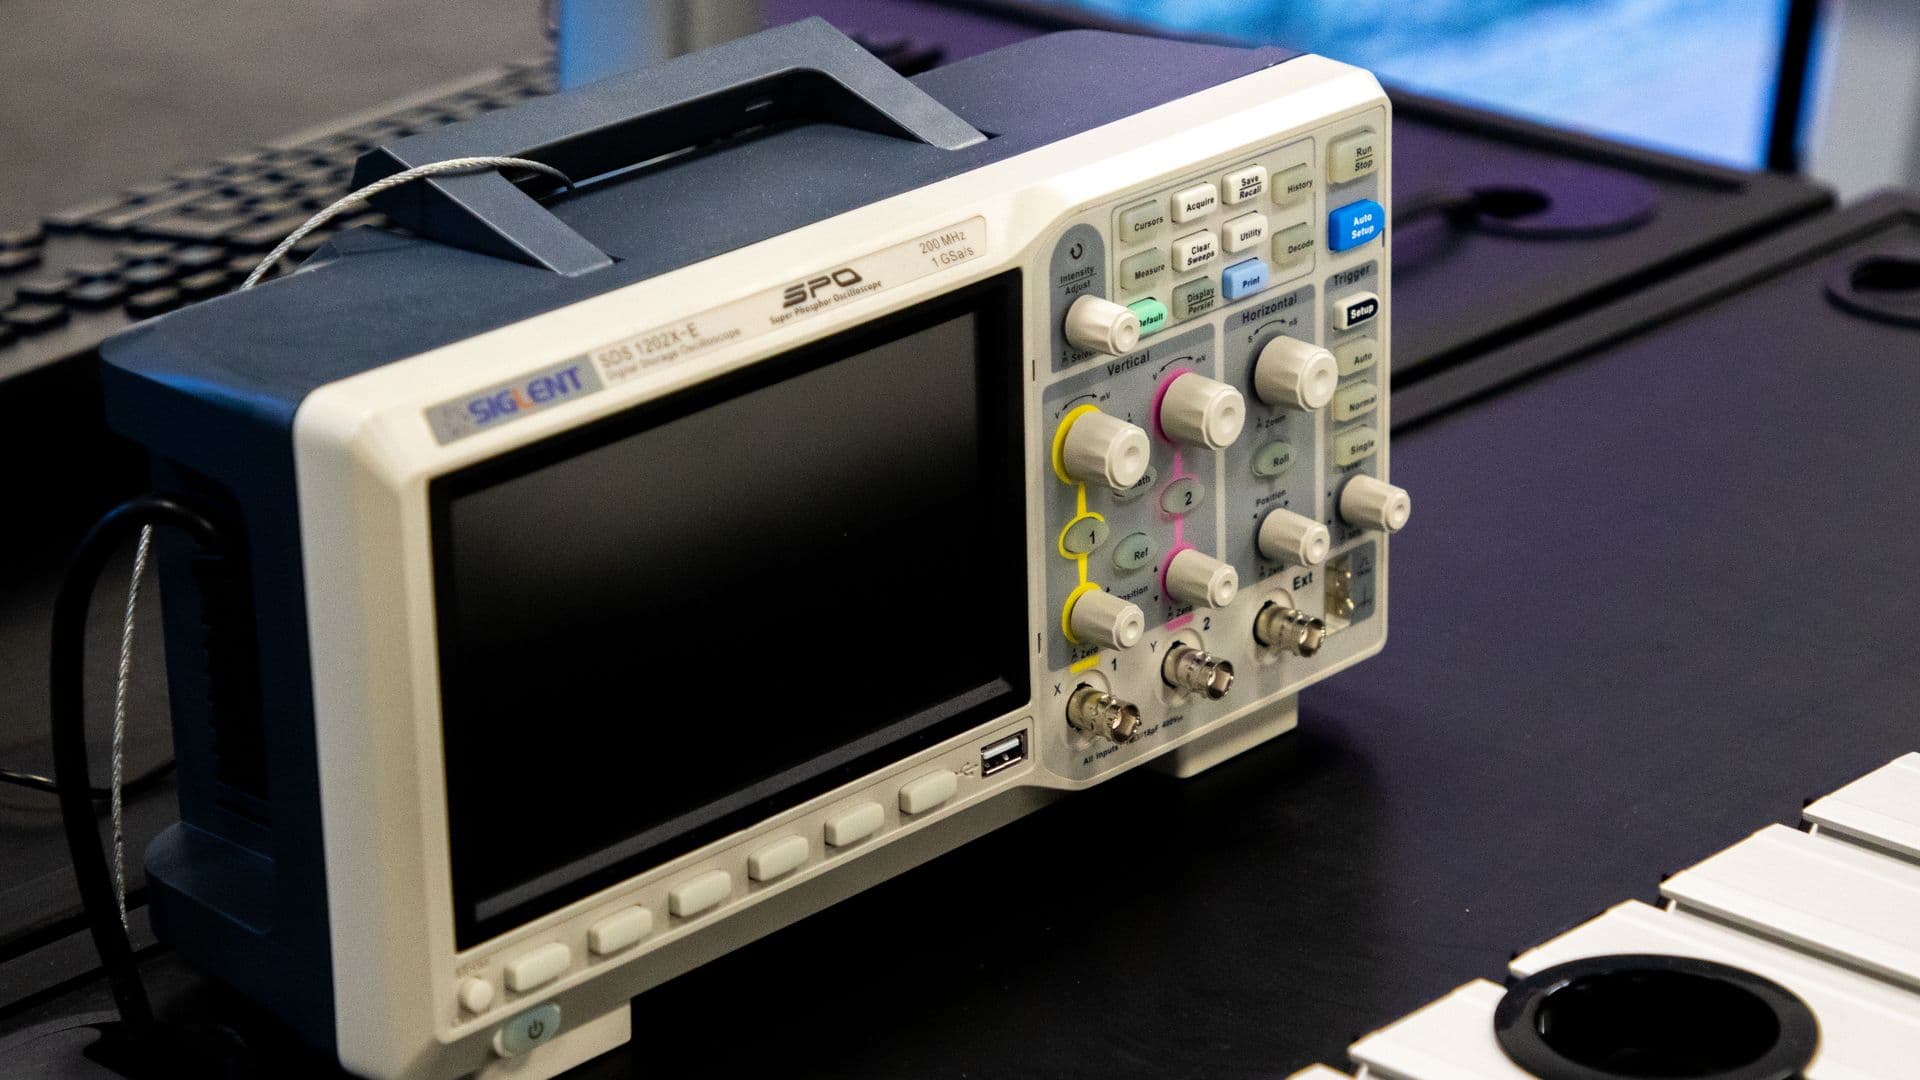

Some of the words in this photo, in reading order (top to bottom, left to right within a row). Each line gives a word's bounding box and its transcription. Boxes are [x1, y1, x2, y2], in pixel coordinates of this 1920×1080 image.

[1356, 145, 1372, 157] Run
[1354, 159, 1373, 172] Stop
[1241, 175, 1259, 187] Save
[1287, 179, 1313, 194] History
[1239, 185, 1262, 199] Recall
[1186, 197, 1215, 212] Acquire
[1134, 216, 1164, 231] Cursors
[1353, 213, 1372, 226] Auto
[1240, 227, 1262, 241] Utility
[1351, 225, 1374, 239] Setup
[919, 238, 941, 255] 200
[940, 231, 967, 247] MHz
[1191, 242, 1211, 255] Clear
[1288, 239, 1314, 254] Decode
[931, 257, 940, 268] 1
[940, 247, 975, 265] GSa/s
[1187, 250, 1215, 266] Sweeps
[1060, 265, 1095, 283] Intensity
[1134, 263, 1165, 280] Measure
[1334, 265, 1370, 287] Trigger
[1065, 280, 1091, 295] Adjust
[1242, 276, 1260, 288] Print
[769, 312, 793, 326] Super
[794, 298, 832, 316] Phosphor
[832, 280, 882, 303] Oscilloscope
[1187, 287, 1215, 304] Display
[1188, 300, 1214, 316] Persist
[1242, 292, 1298, 324] Horizontal
[1350, 303, 1374, 319] Setup
[598, 345, 633, 368] SDS
[1107, 350, 1150, 376] Vertical
[1354, 352, 1372, 365] Auto
[468, 366, 582, 425] SIGLENT
[1349, 396, 1376, 412] Normal
[1351, 439, 1375, 455] Single
[1273, 453, 1290, 467] Roll
[1185, 490, 1193, 506] 2
[1256, 489, 1287, 507] Position
[1089, 530, 1095, 544] 1
[1134, 547, 1149, 561] Ref
[1293, 571, 1312, 591] Ext
[1203, 616, 1211, 631] 2
[1150, 641, 1158, 653] Y
[1111, 657, 1117, 671] 1
[1053, 682, 1062, 697] X
[1083, 755, 1094, 766] All
